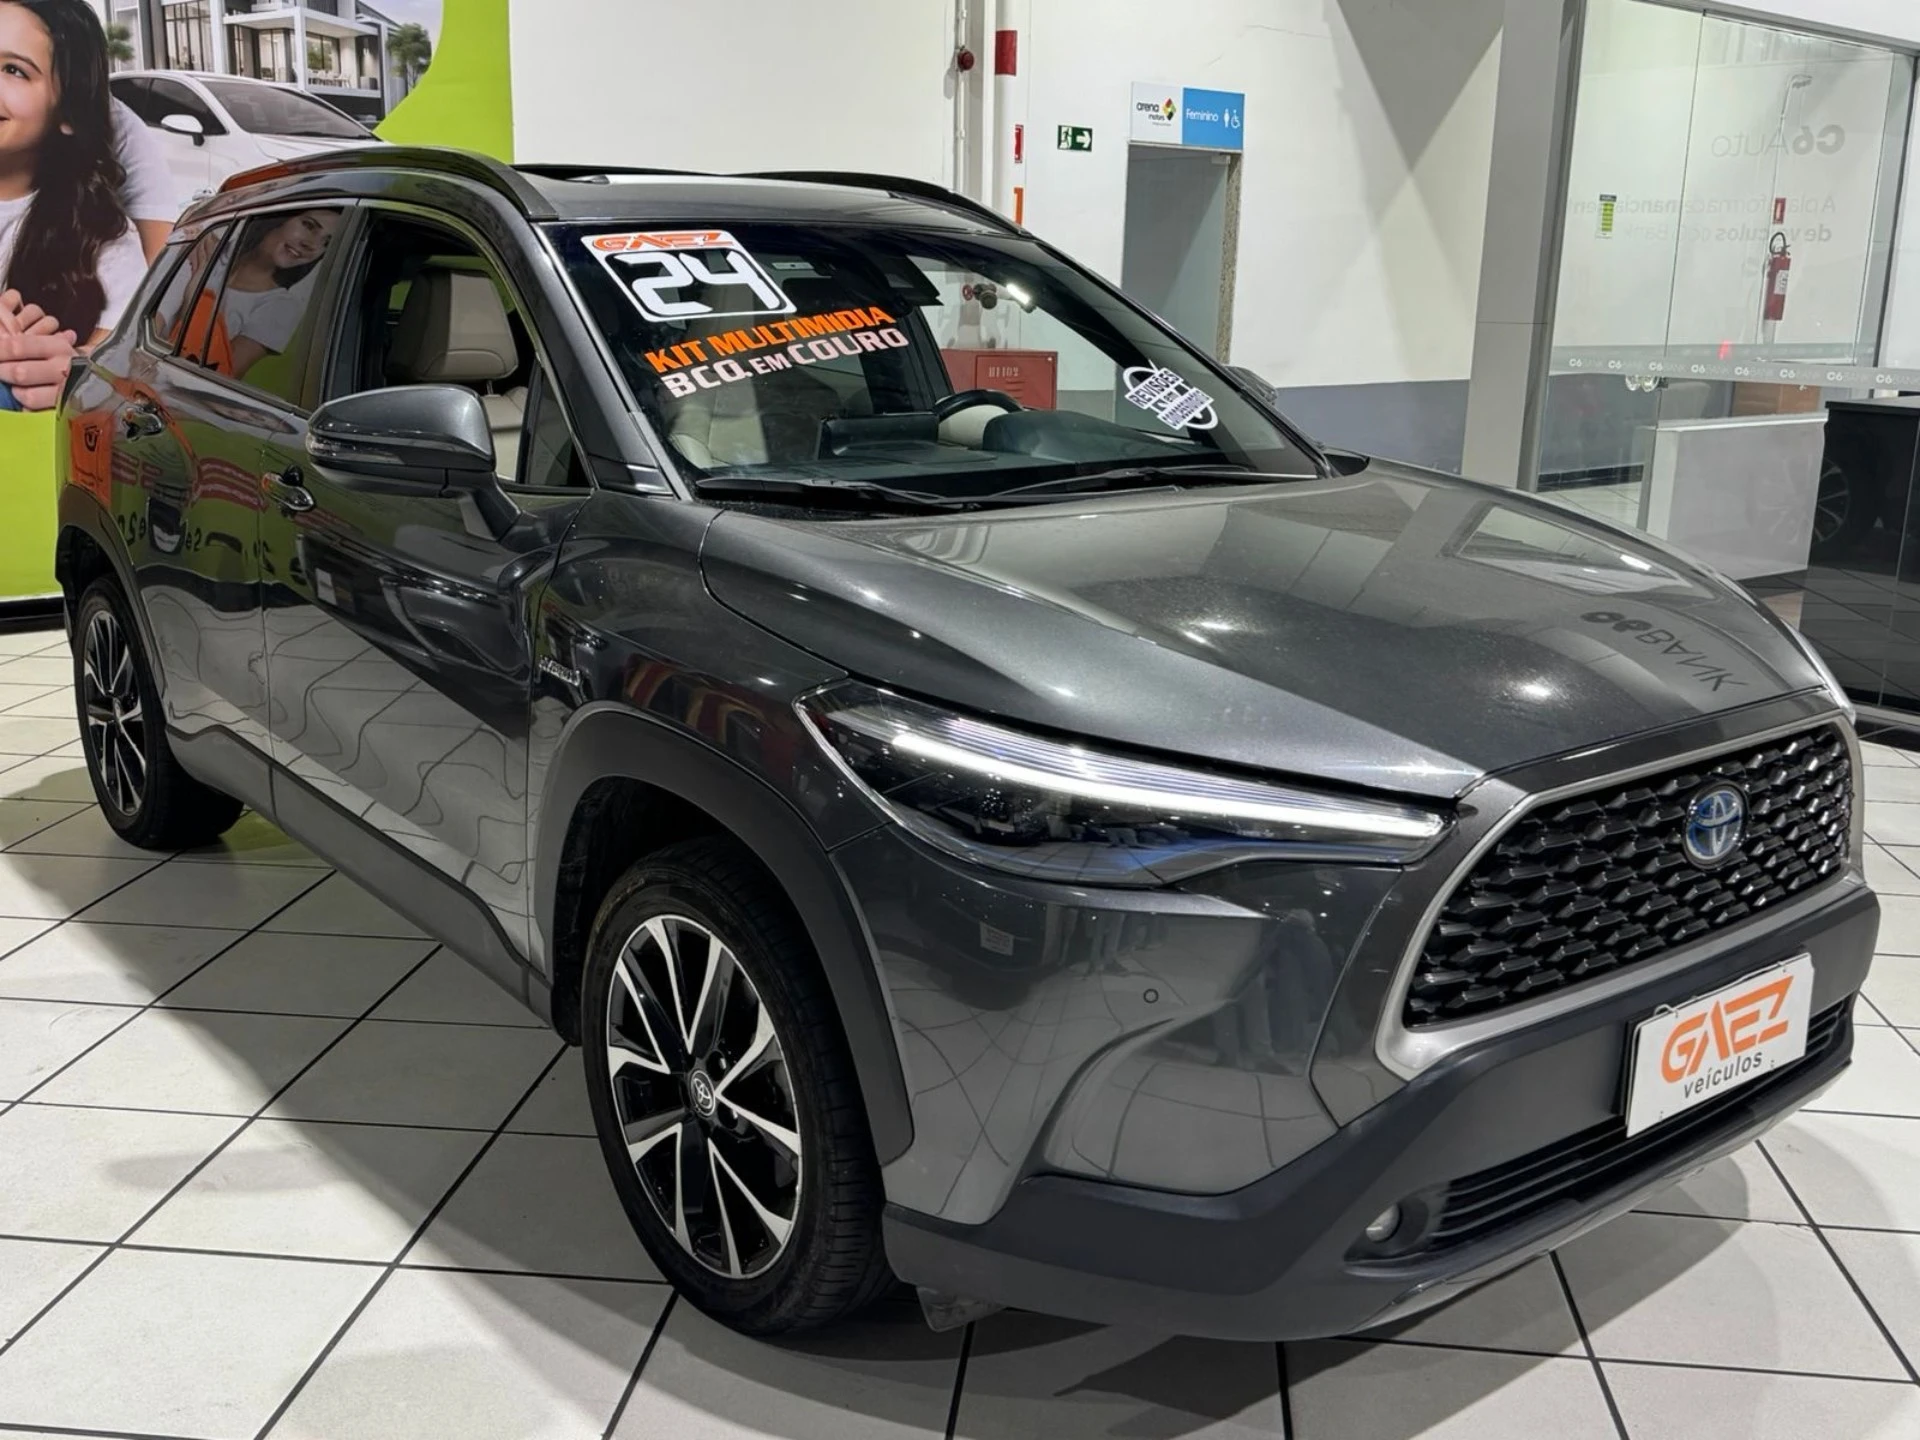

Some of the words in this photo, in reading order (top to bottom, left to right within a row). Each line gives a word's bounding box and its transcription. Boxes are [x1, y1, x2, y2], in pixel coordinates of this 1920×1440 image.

[1136, 102, 1160, 113] arena
[1186, 108, 1219, 122] Feminino
[613, 250, 781, 316] 24
[644, 340, 709, 373] KIT
[660, 358, 754, 398] BCO.
[748, 352, 793, 375] EM
[786, 328, 909, 366] COURO
[1661, 975, 1794, 1084] GAEZ
[1683, 1051, 1763, 1099] veículos
